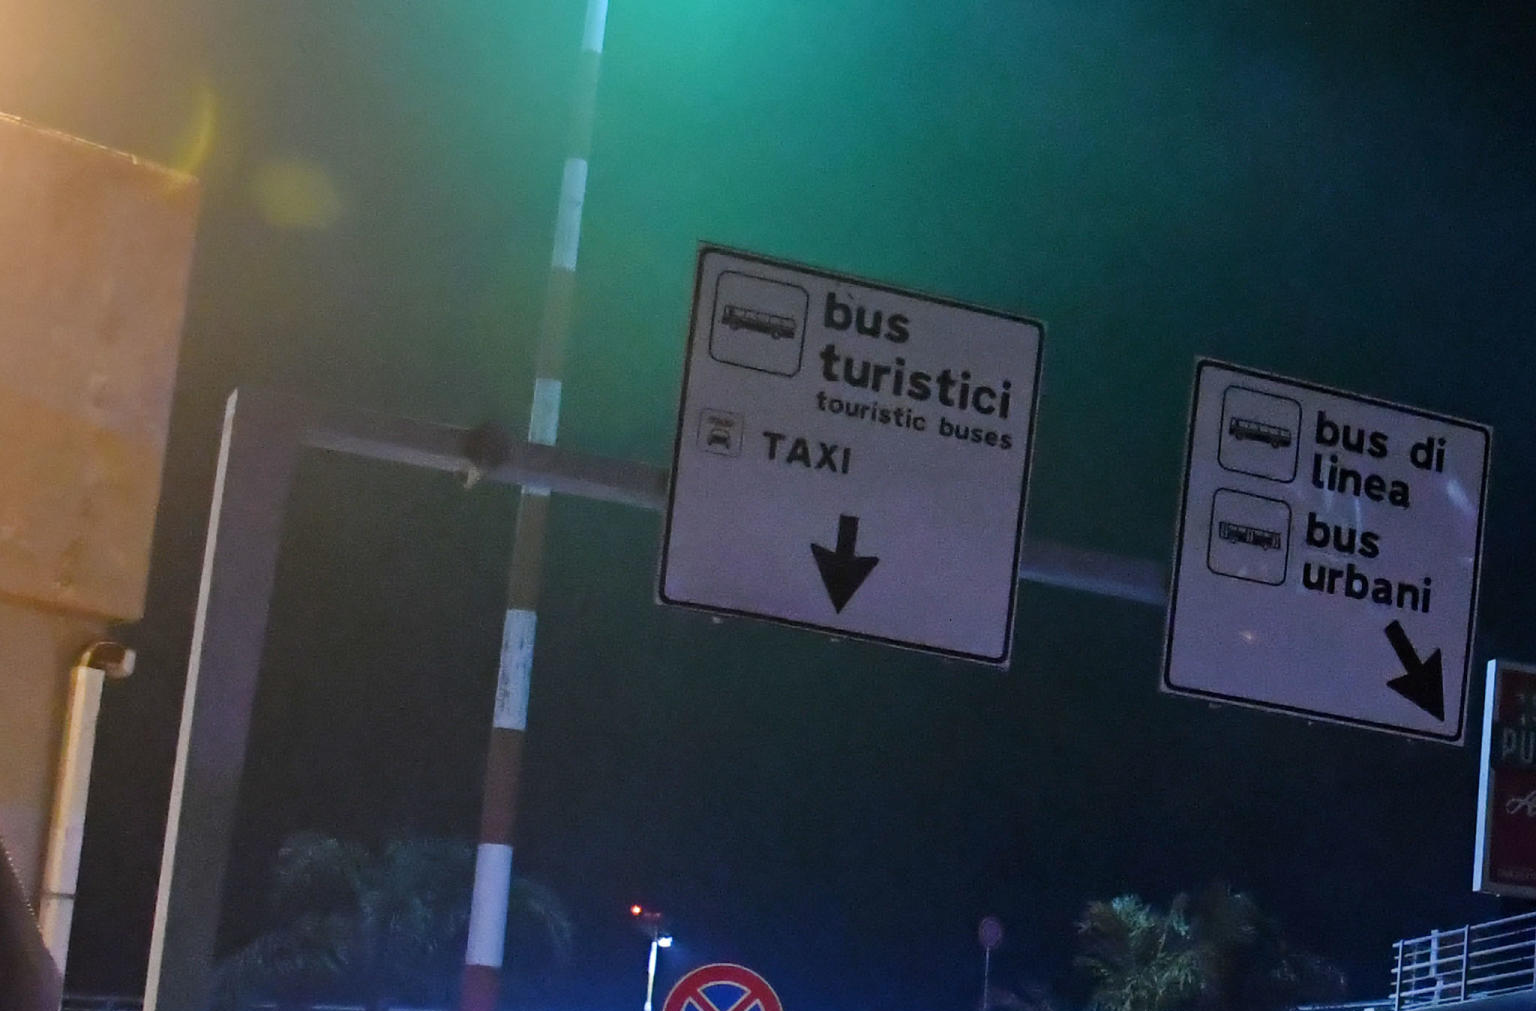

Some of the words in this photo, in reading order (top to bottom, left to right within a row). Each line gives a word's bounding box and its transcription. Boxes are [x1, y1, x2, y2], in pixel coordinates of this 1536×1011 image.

[823, 291, 911, 344] bus
[819, 343, 1013, 420] turistici
[816, 390, 926, 432] touristic
[939, 416, 1014, 450] buses
[1314, 410, 1389, 459] bus
[1409, 436, 1447, 473] di
[762, 430, 852, 474] TAXI
[1312, 453, 1411, 510] linea
[1305, 511, 1381, 559] bus
[1302, 562, 1433, 613] urbani
